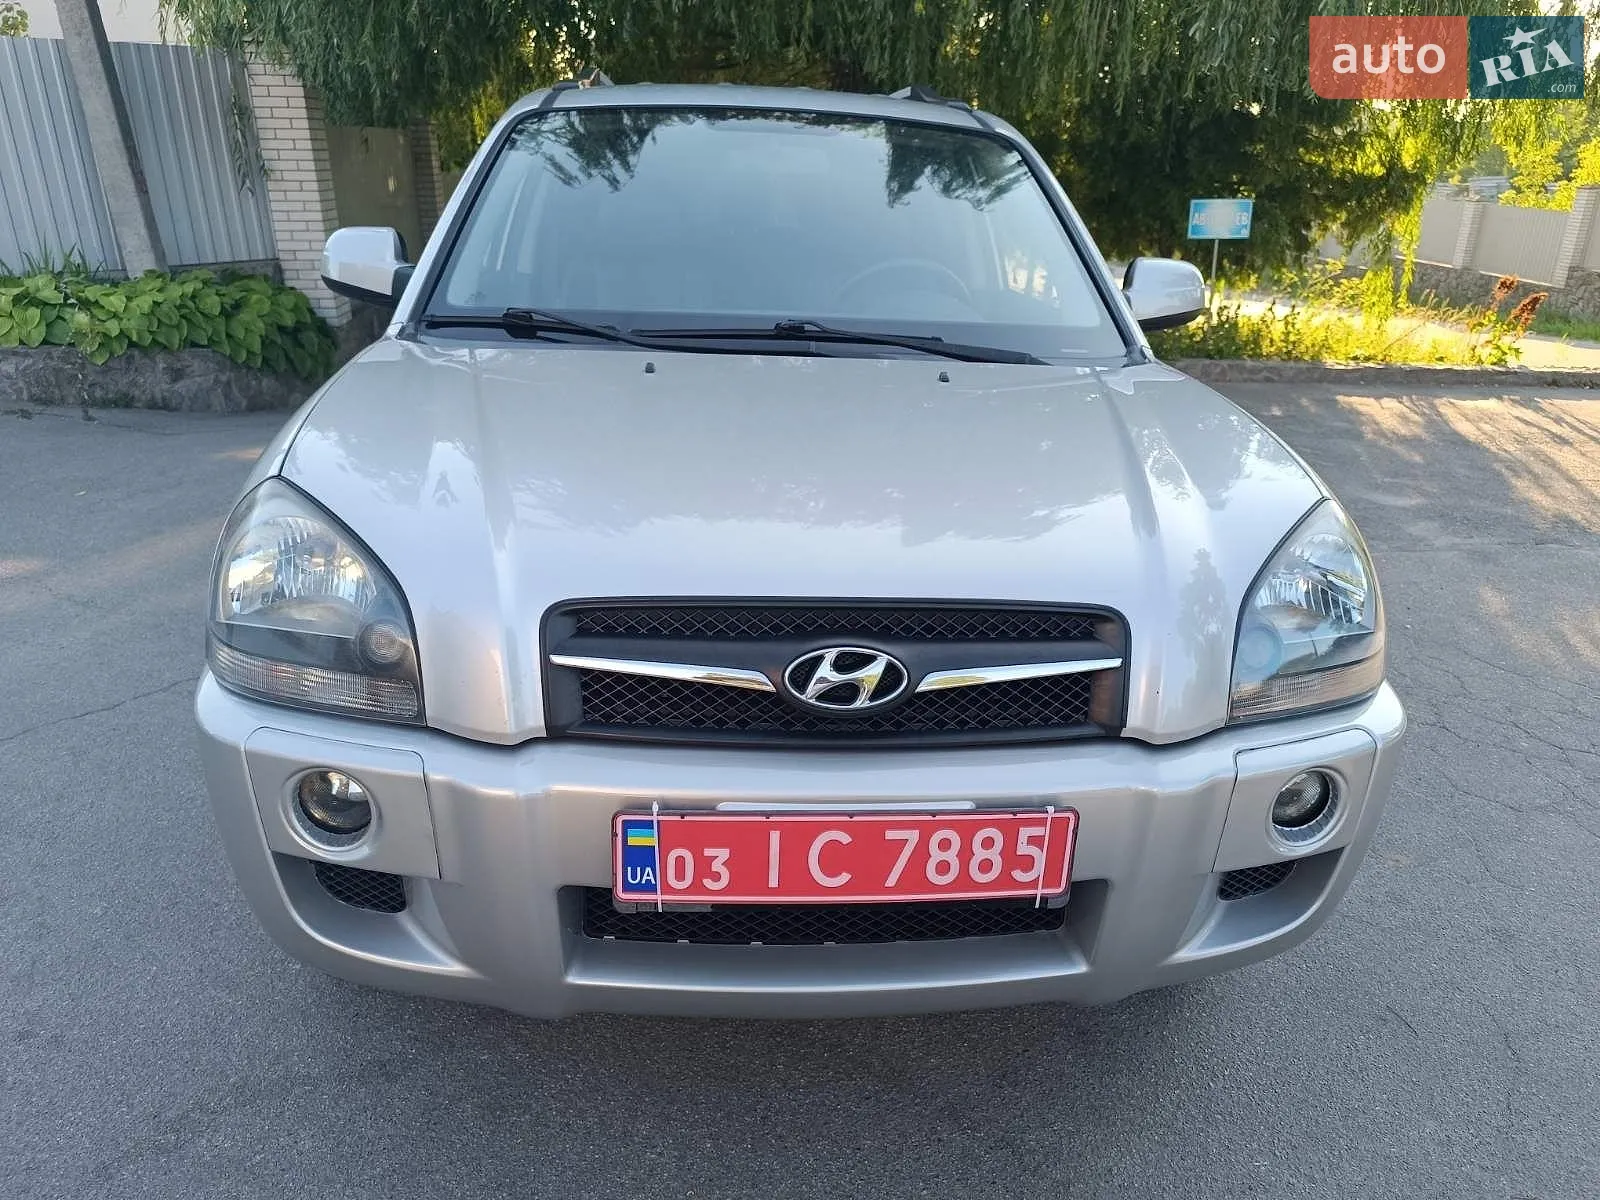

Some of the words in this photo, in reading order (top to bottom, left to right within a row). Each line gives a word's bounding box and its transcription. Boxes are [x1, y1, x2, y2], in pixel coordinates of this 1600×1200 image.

[627, 866, 656, 885] UA
[666, 848, 731, 891] 03
[884, 827, 1047, 888] 7885
